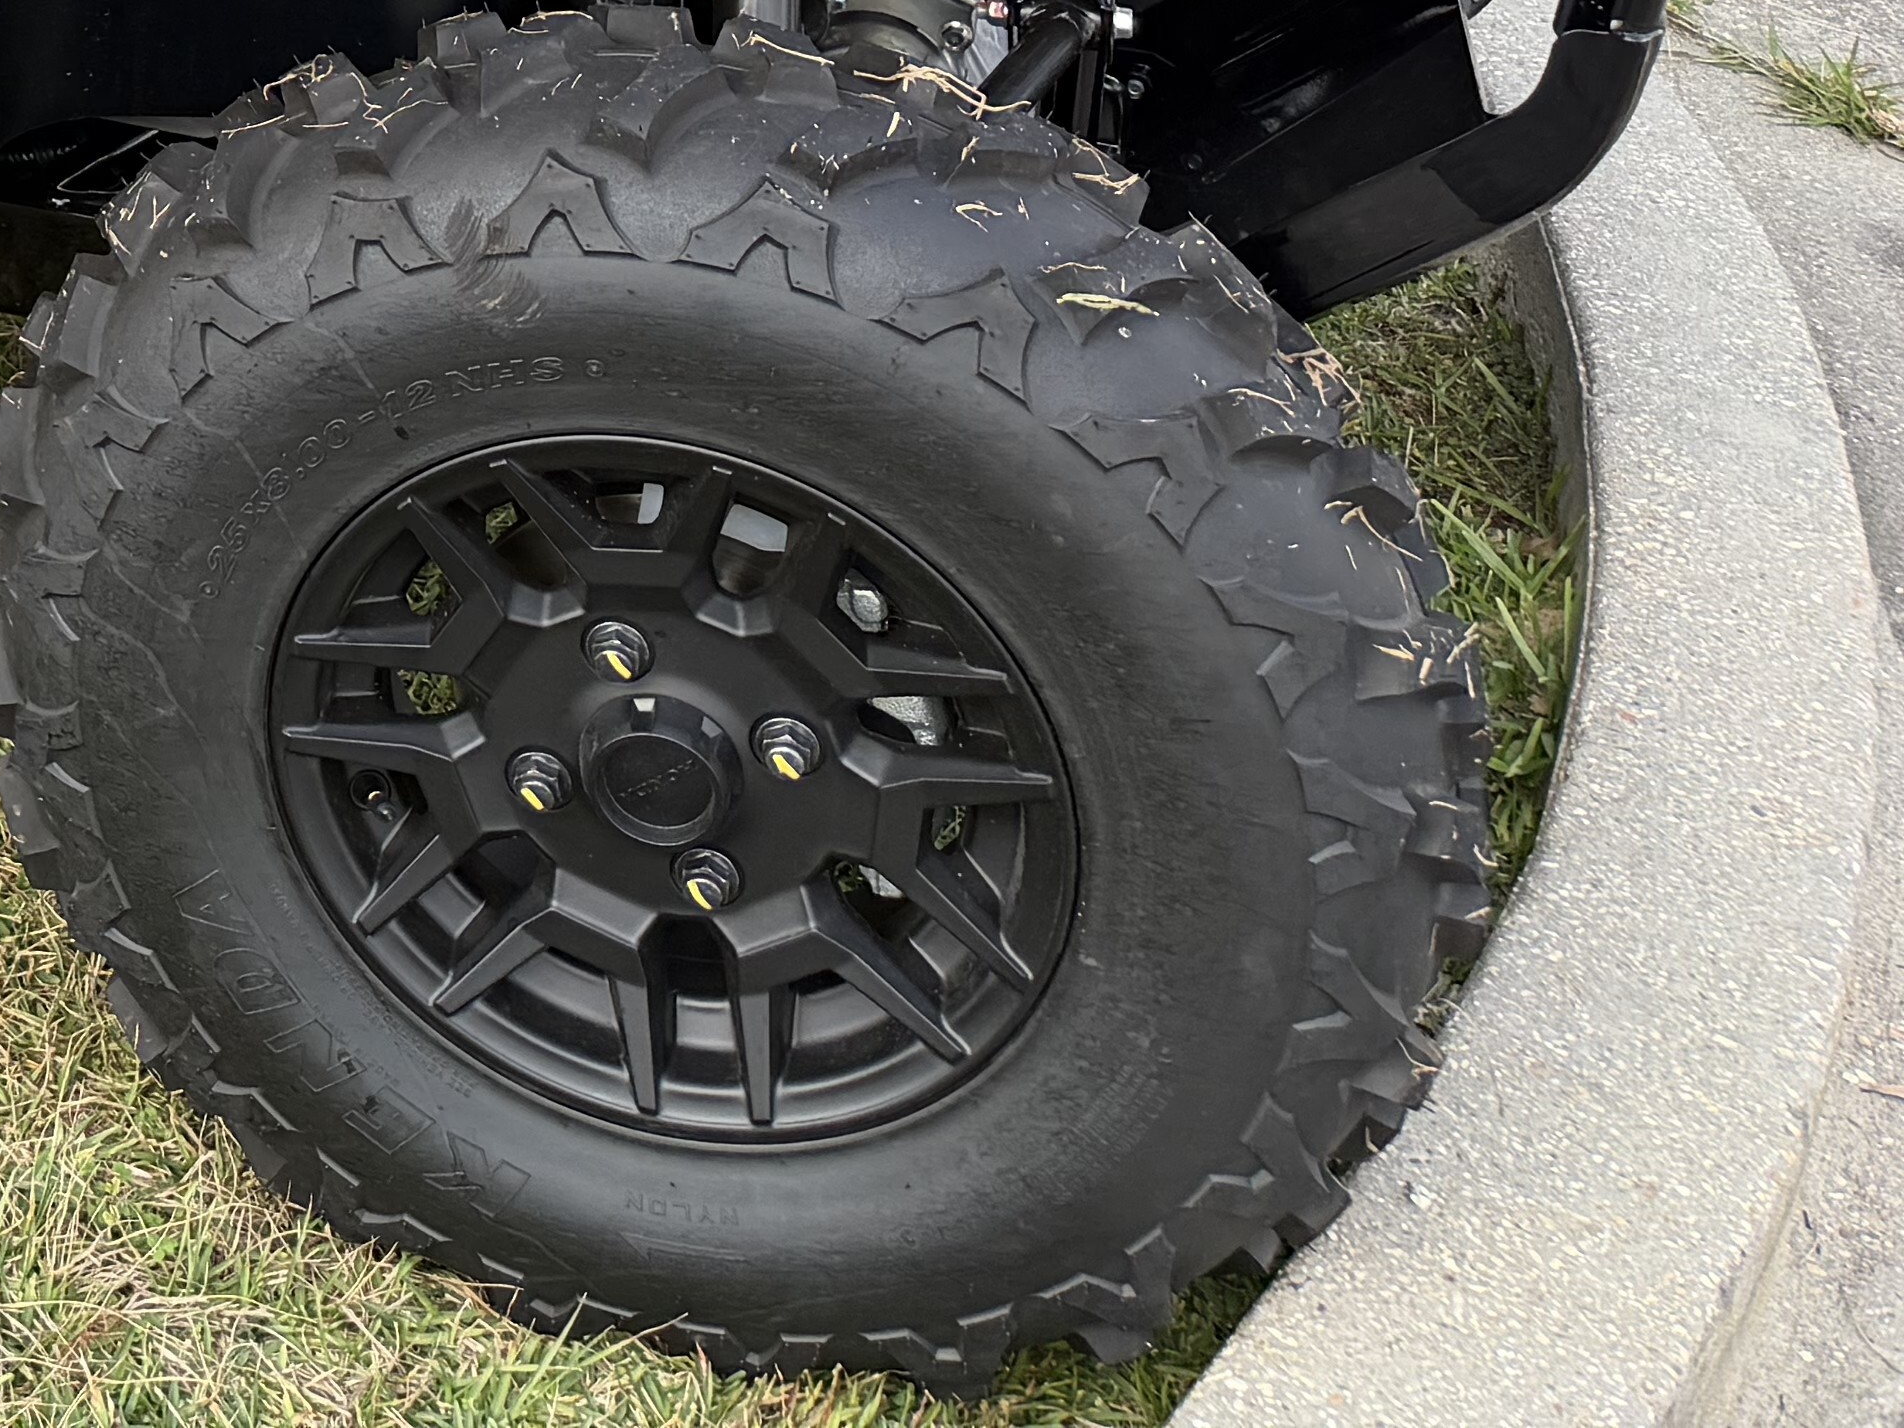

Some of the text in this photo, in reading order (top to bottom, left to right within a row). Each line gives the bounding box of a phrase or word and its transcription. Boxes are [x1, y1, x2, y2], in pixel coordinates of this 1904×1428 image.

[444, 356, 565, 399] NHS
[173, 869, 532, 1219] KENDA
[625, 1190, 739, 1226] NYLON
